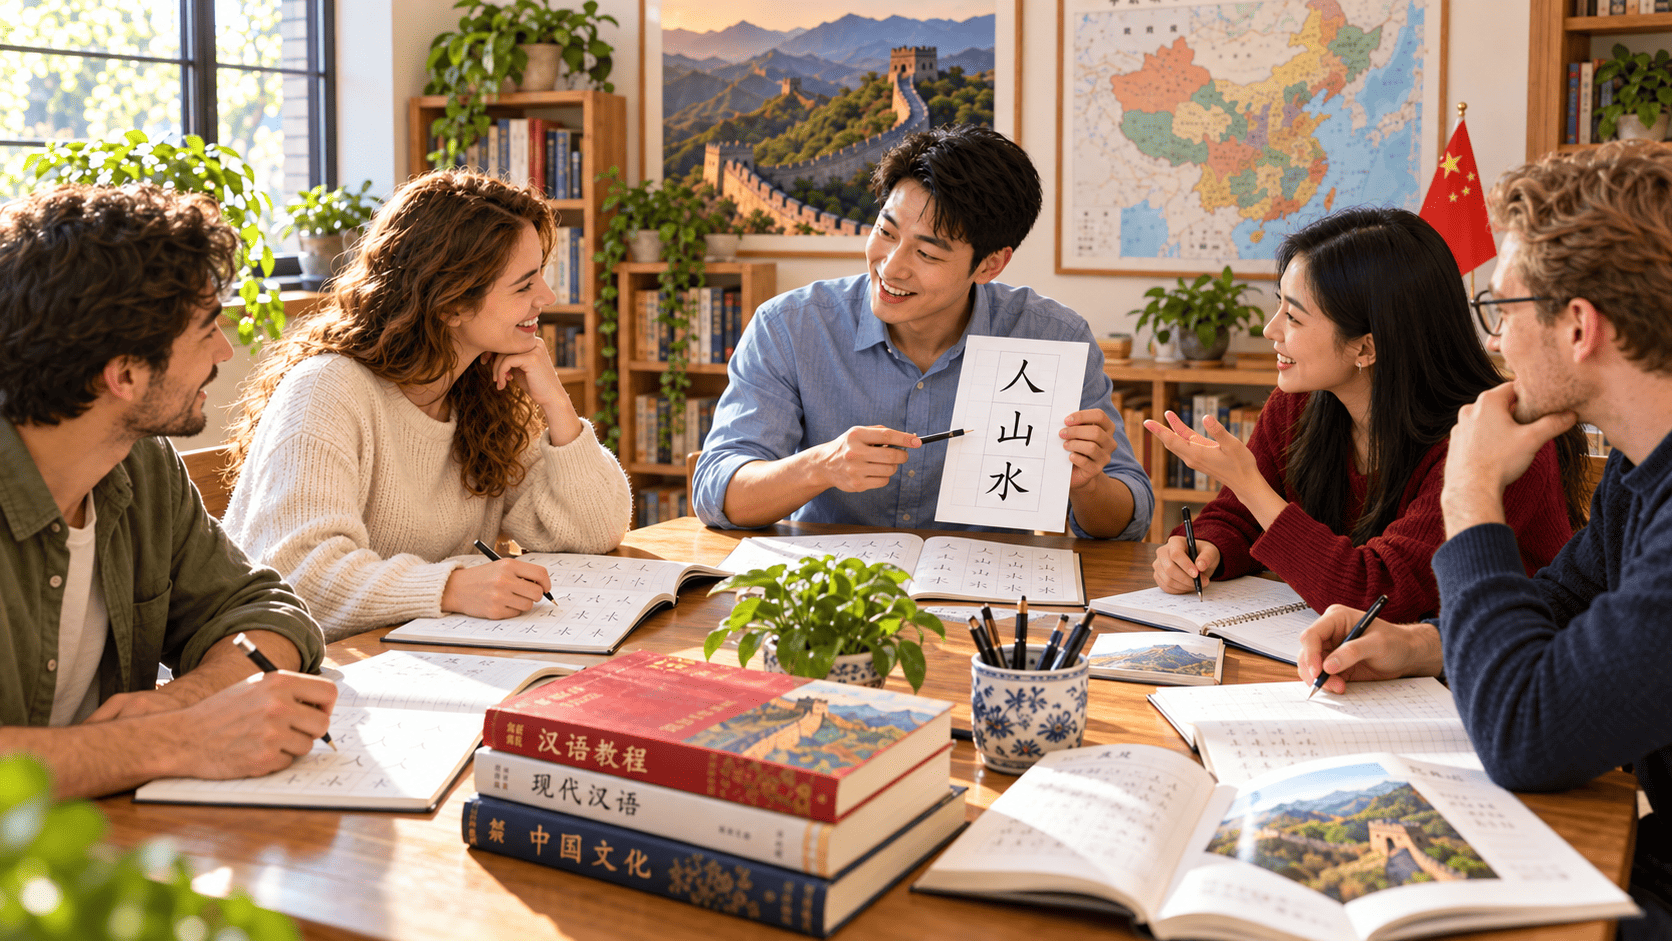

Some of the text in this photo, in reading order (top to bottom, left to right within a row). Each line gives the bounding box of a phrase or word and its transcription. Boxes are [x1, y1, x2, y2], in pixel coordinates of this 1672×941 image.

[985, 359, 1045, 501] 人山水
[537, 728, 649, 773] 汉语教程
[531, 773, 642, 816] 现代汉语
[529, 824, 653, 880] 中国文化
